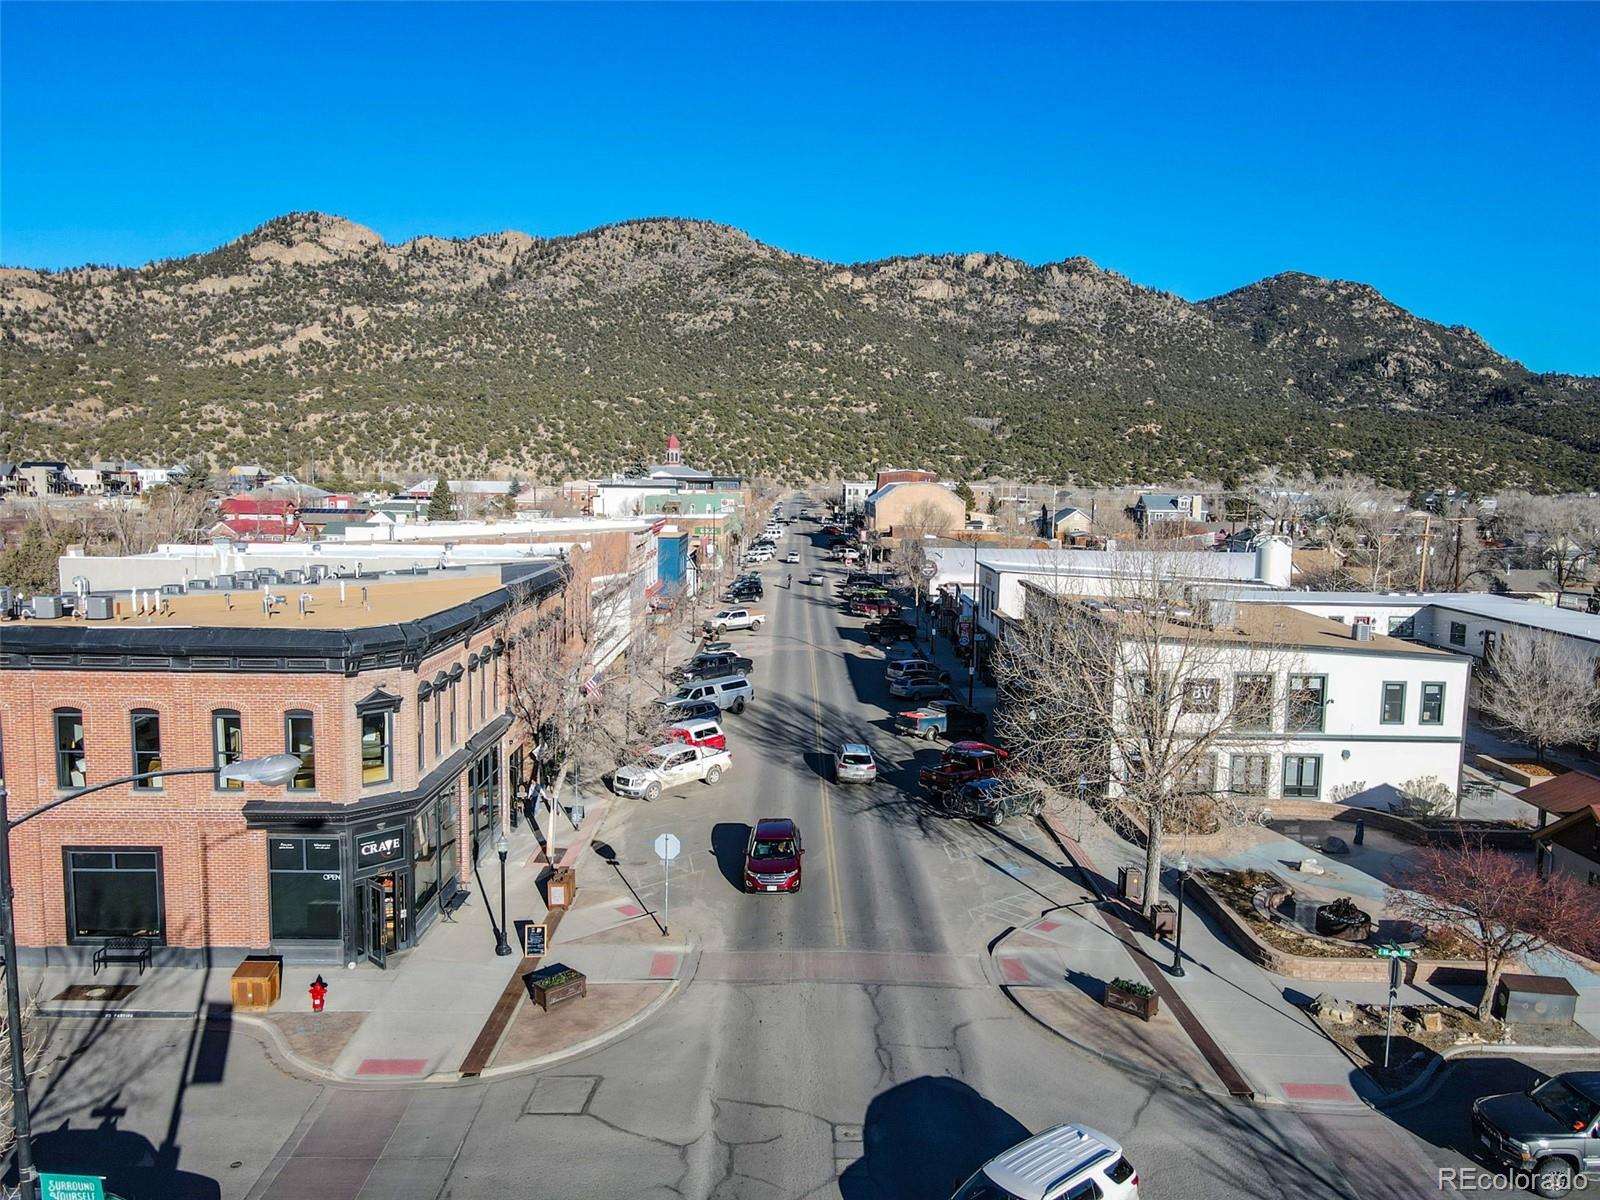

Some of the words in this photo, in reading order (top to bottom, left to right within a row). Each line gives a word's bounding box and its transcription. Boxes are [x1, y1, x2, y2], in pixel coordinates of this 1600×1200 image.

[361, 838, 400, 855] CRAVE
[48, 1180, 95, 1192] SURROUND
[49, 1191, 95, 1200] YOURSELF
